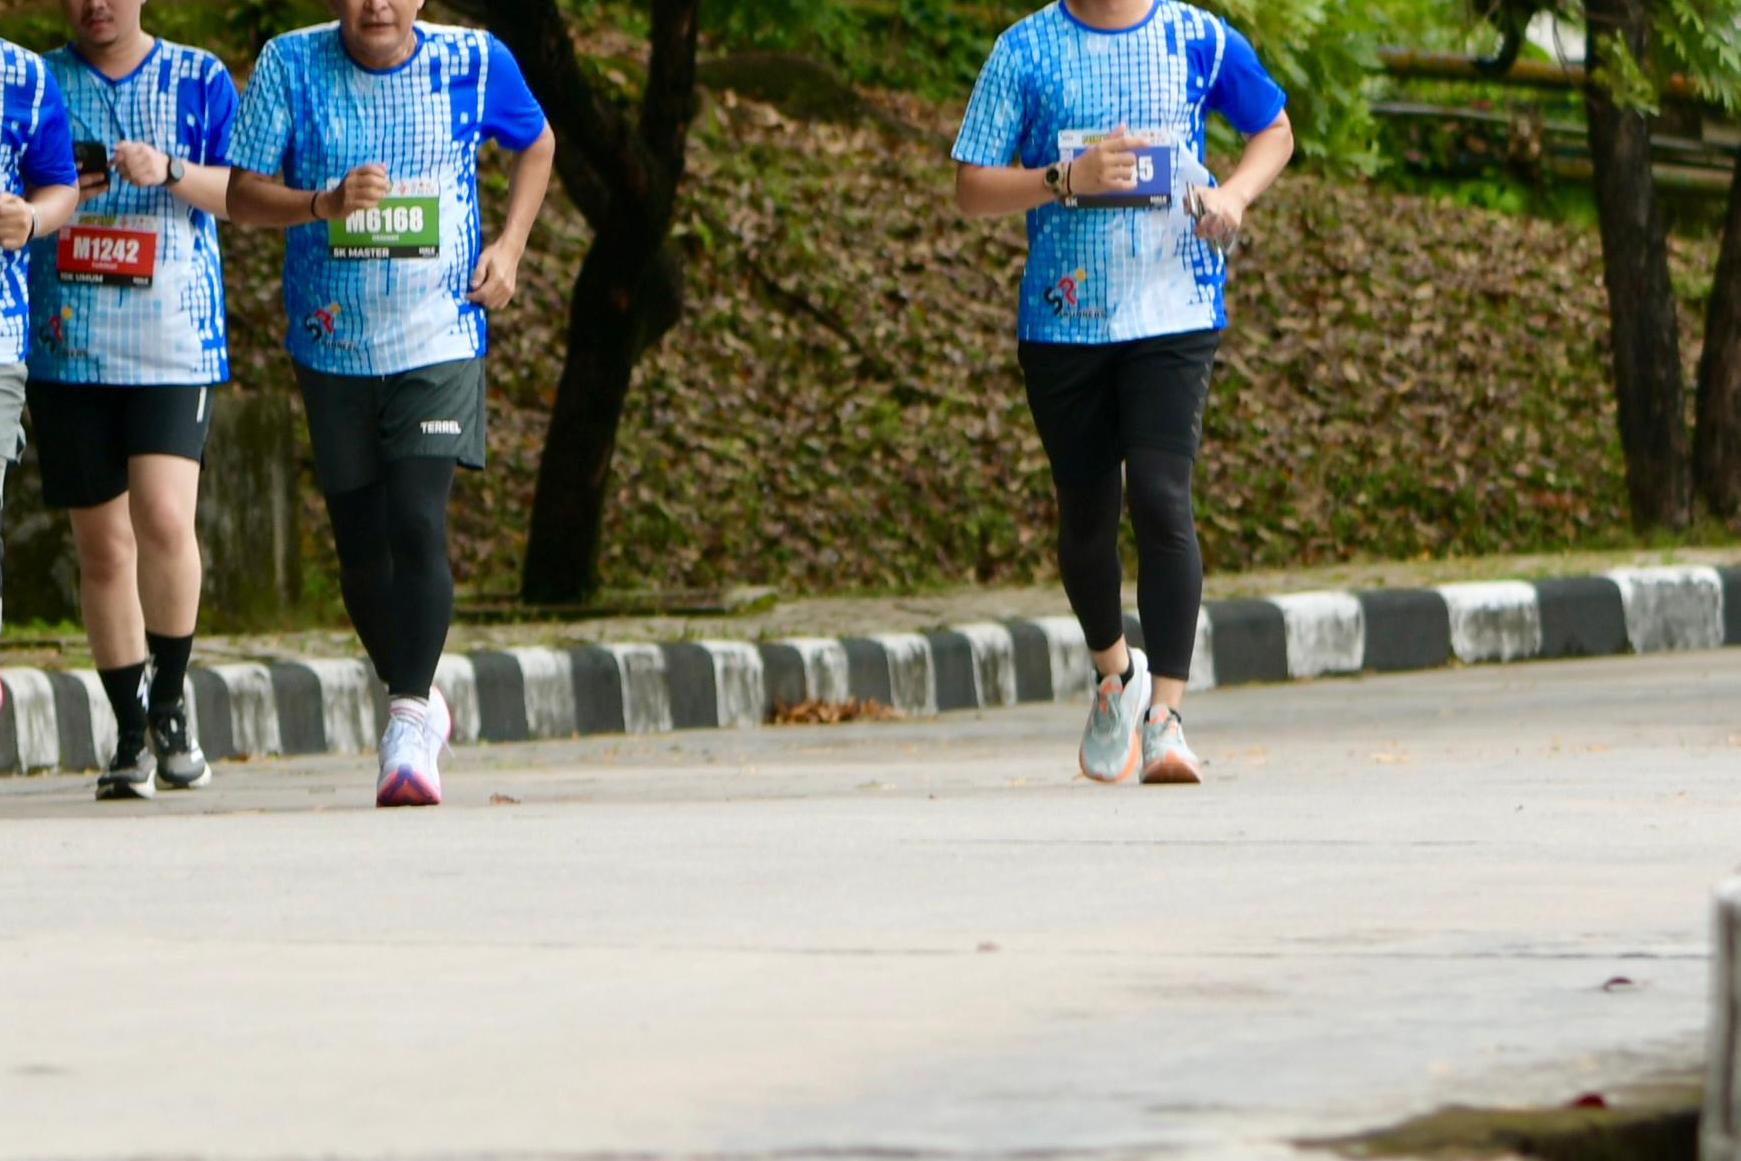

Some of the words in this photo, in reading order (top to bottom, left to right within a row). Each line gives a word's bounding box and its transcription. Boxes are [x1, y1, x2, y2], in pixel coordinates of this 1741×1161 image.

[345, 206, 423, 233] M6168
[73, 236, 140, 264] M1242
[348, 247, 390, 258] MASTER
[420, 420, 462, 434] TERREL
